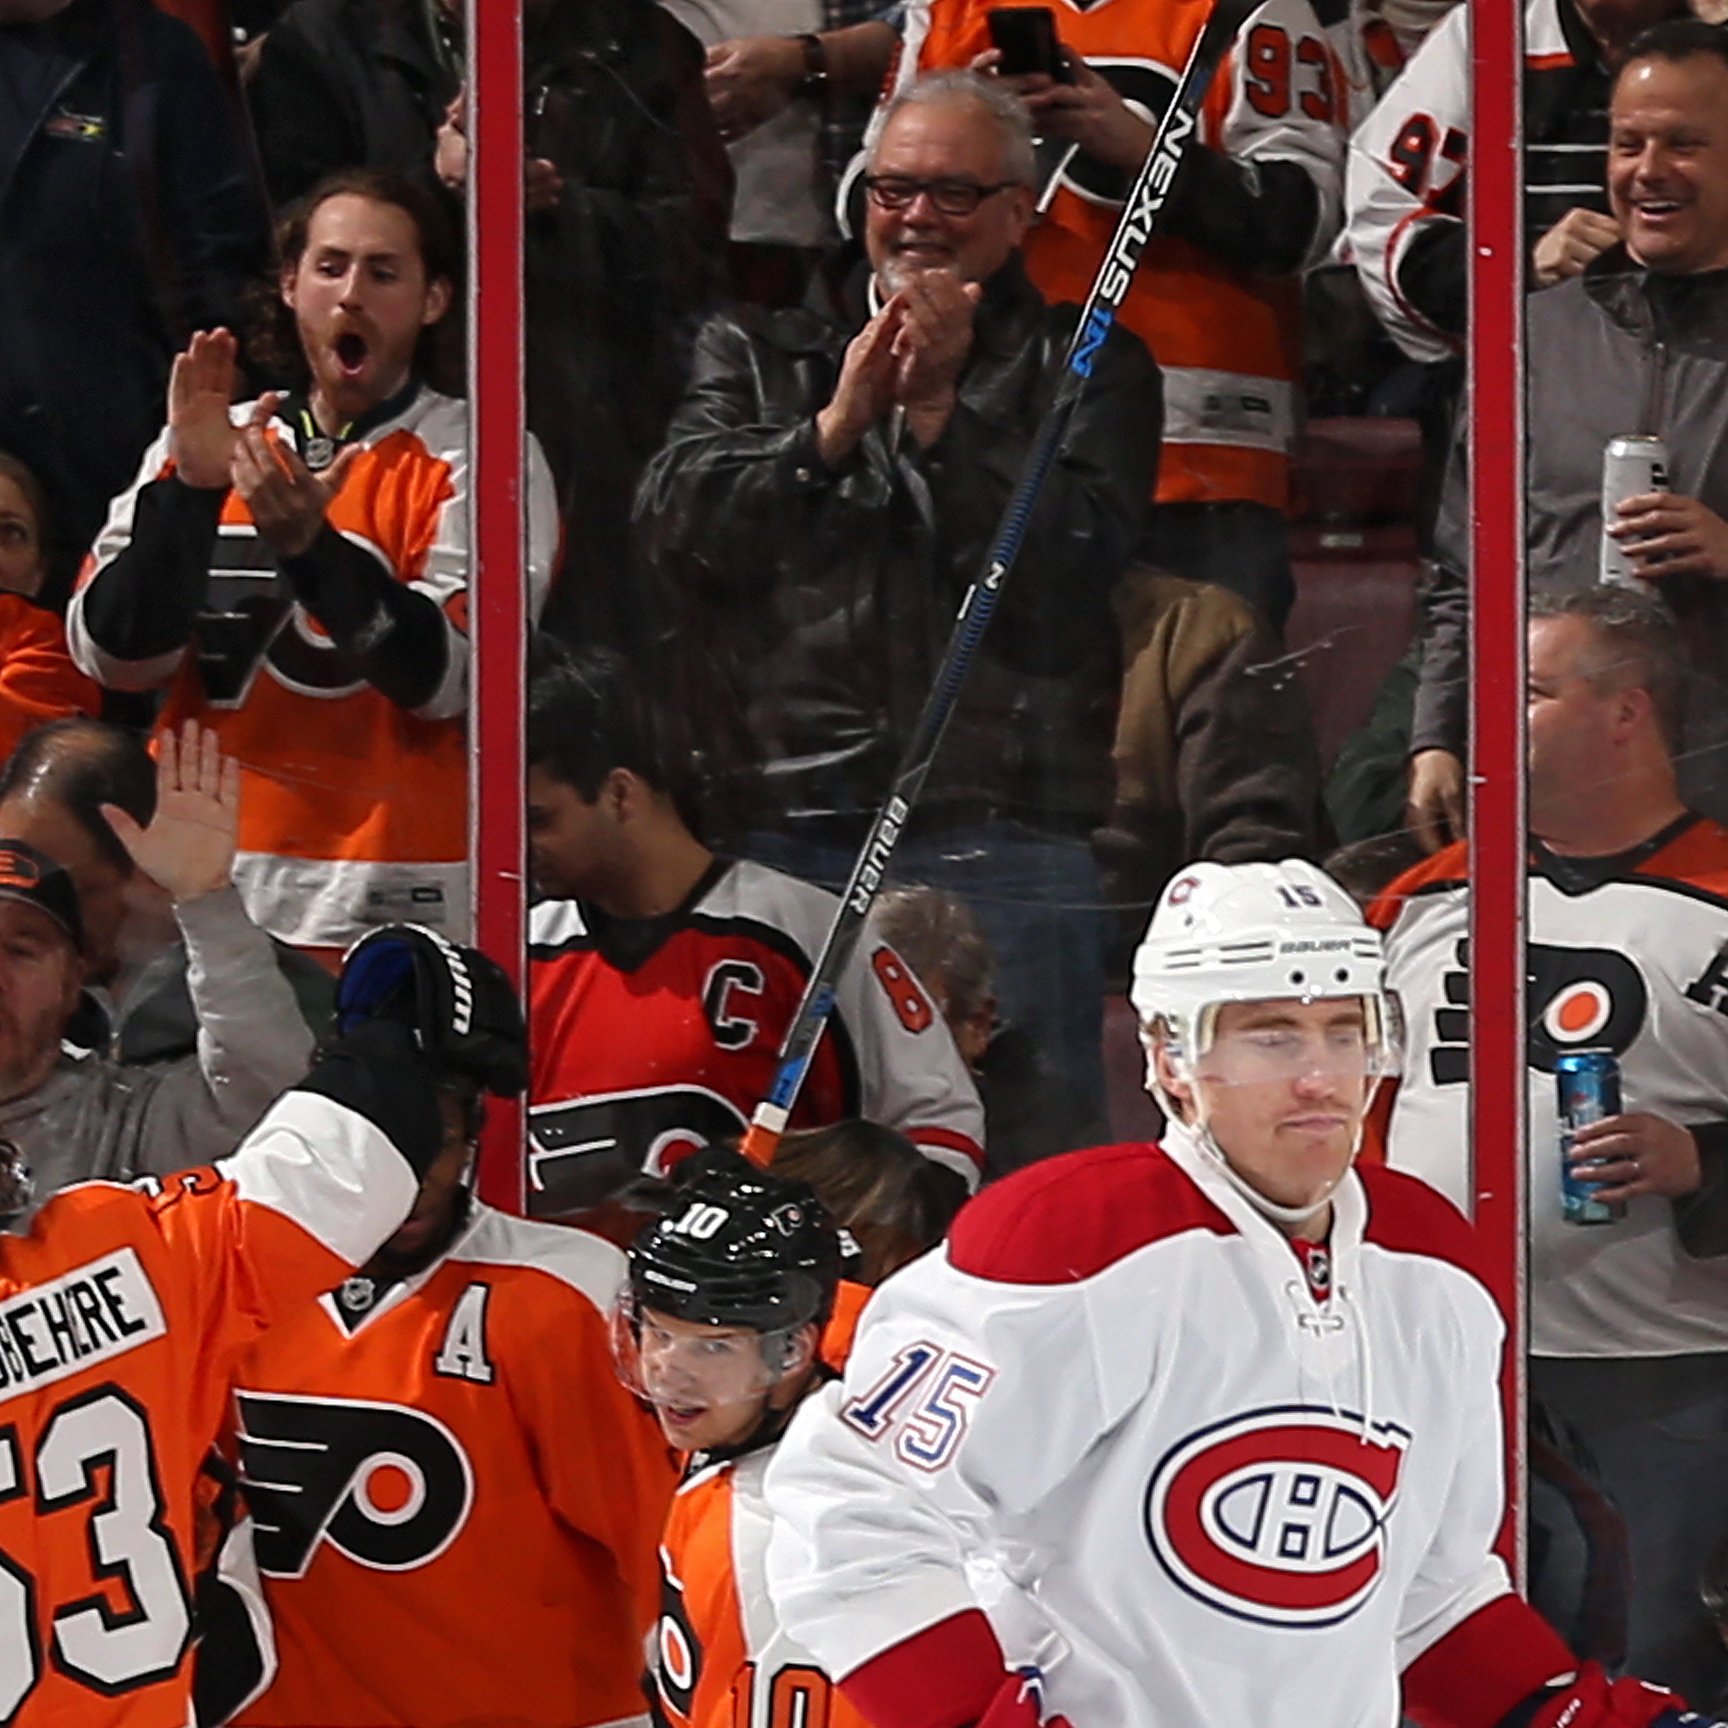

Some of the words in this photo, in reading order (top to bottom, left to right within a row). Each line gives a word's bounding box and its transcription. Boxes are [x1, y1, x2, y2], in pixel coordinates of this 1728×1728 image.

[1245, 24, 1336, 122] 93
[1100, 106, 1196, 307] NEXUS
[849, 795, 909, 914] BAUER
[1277, 884, 1323, 909] 15
[703, 958, 764, 1050] C
[674, 1202, 729, 1240] 10
[435, 1283, 495, 1384] A
[839, 1337, 997, 1474] 15
